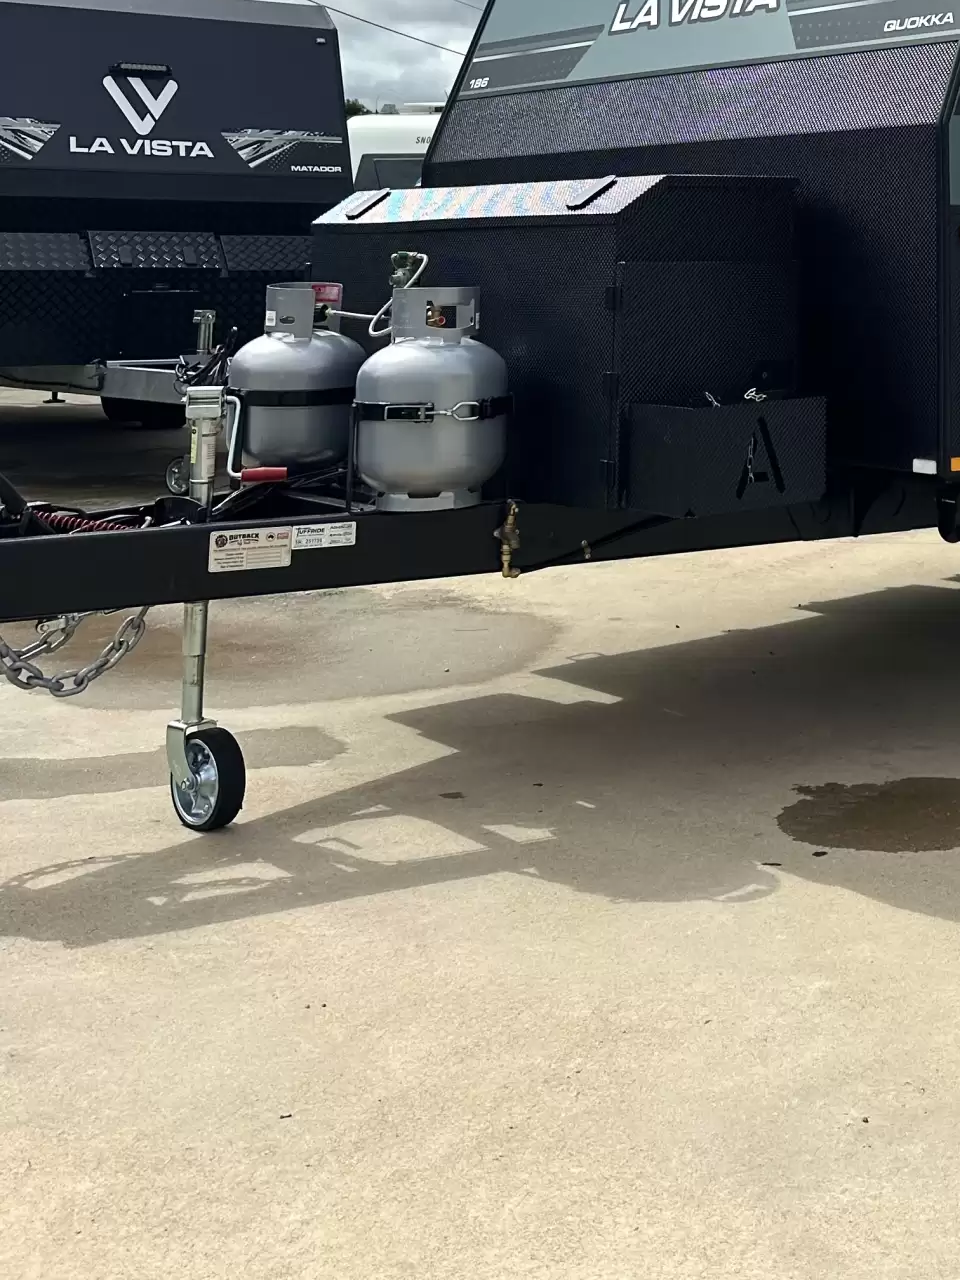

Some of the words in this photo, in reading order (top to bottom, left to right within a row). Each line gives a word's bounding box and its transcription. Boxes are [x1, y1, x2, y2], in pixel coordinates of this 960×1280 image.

[883, 12, 955, 32] QUOKKA
[469, 77, 490, 89] 186
[69, 136, 116, 154] LA
[119, 138, 215, 158] VISTA
[290, 165, 342, 173] MATADOR
[229, 533, 260, 541] OUTBACK
